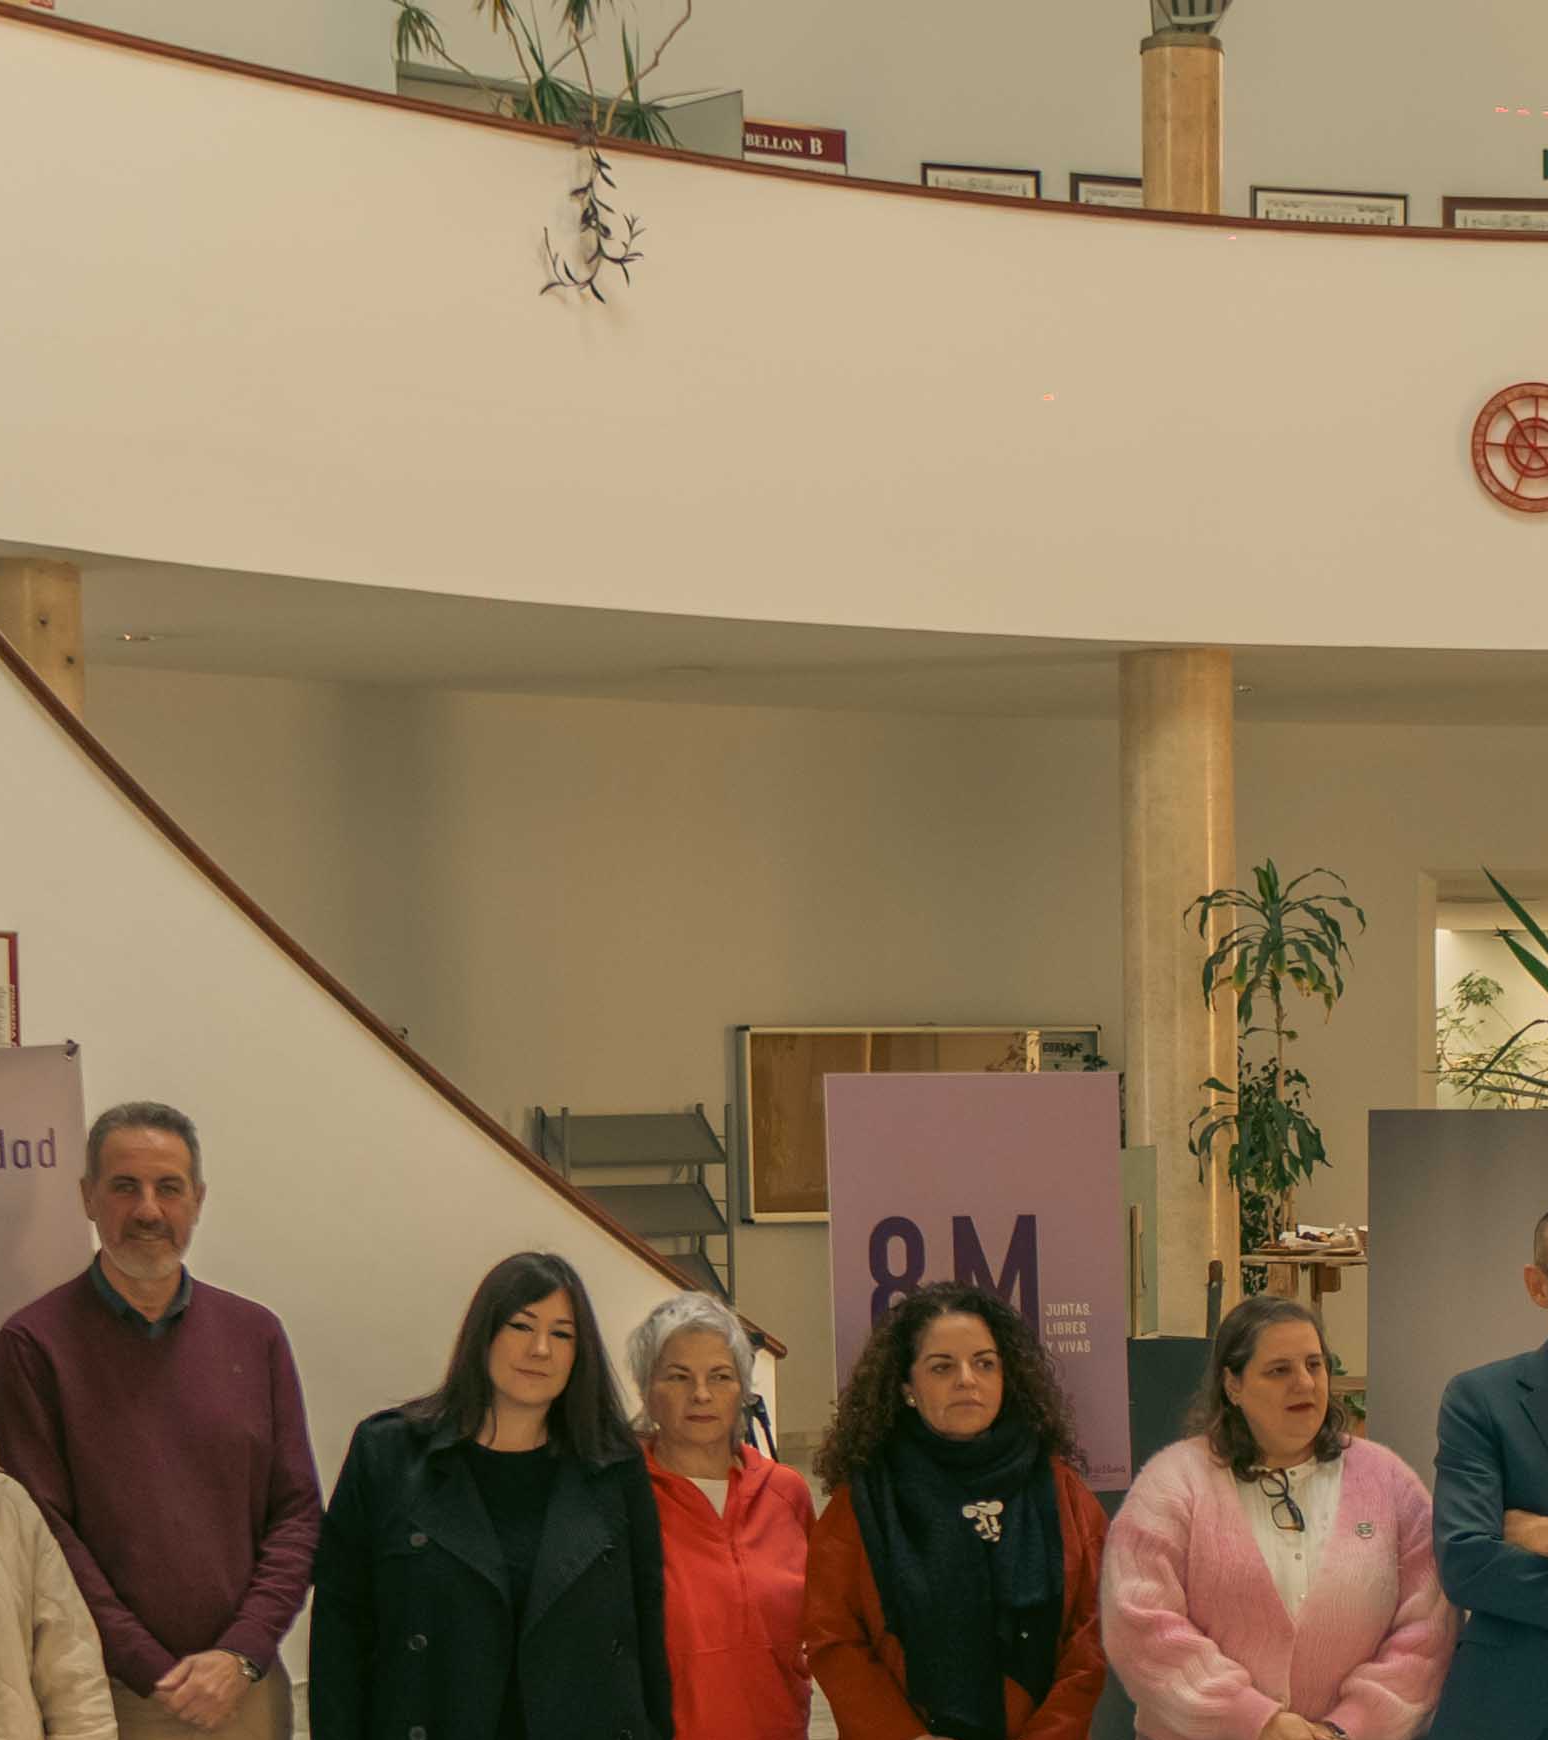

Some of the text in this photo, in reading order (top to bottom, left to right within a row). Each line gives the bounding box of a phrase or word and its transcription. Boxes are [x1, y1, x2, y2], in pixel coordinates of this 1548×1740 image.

[745, 133, 824, 156] BELLON B
[869, 1215, 1041, 1342] 8M
[1046, 1321, 1087, 1336] LIBRES
[1058, 1336, 1092, 1353] VIVAS
